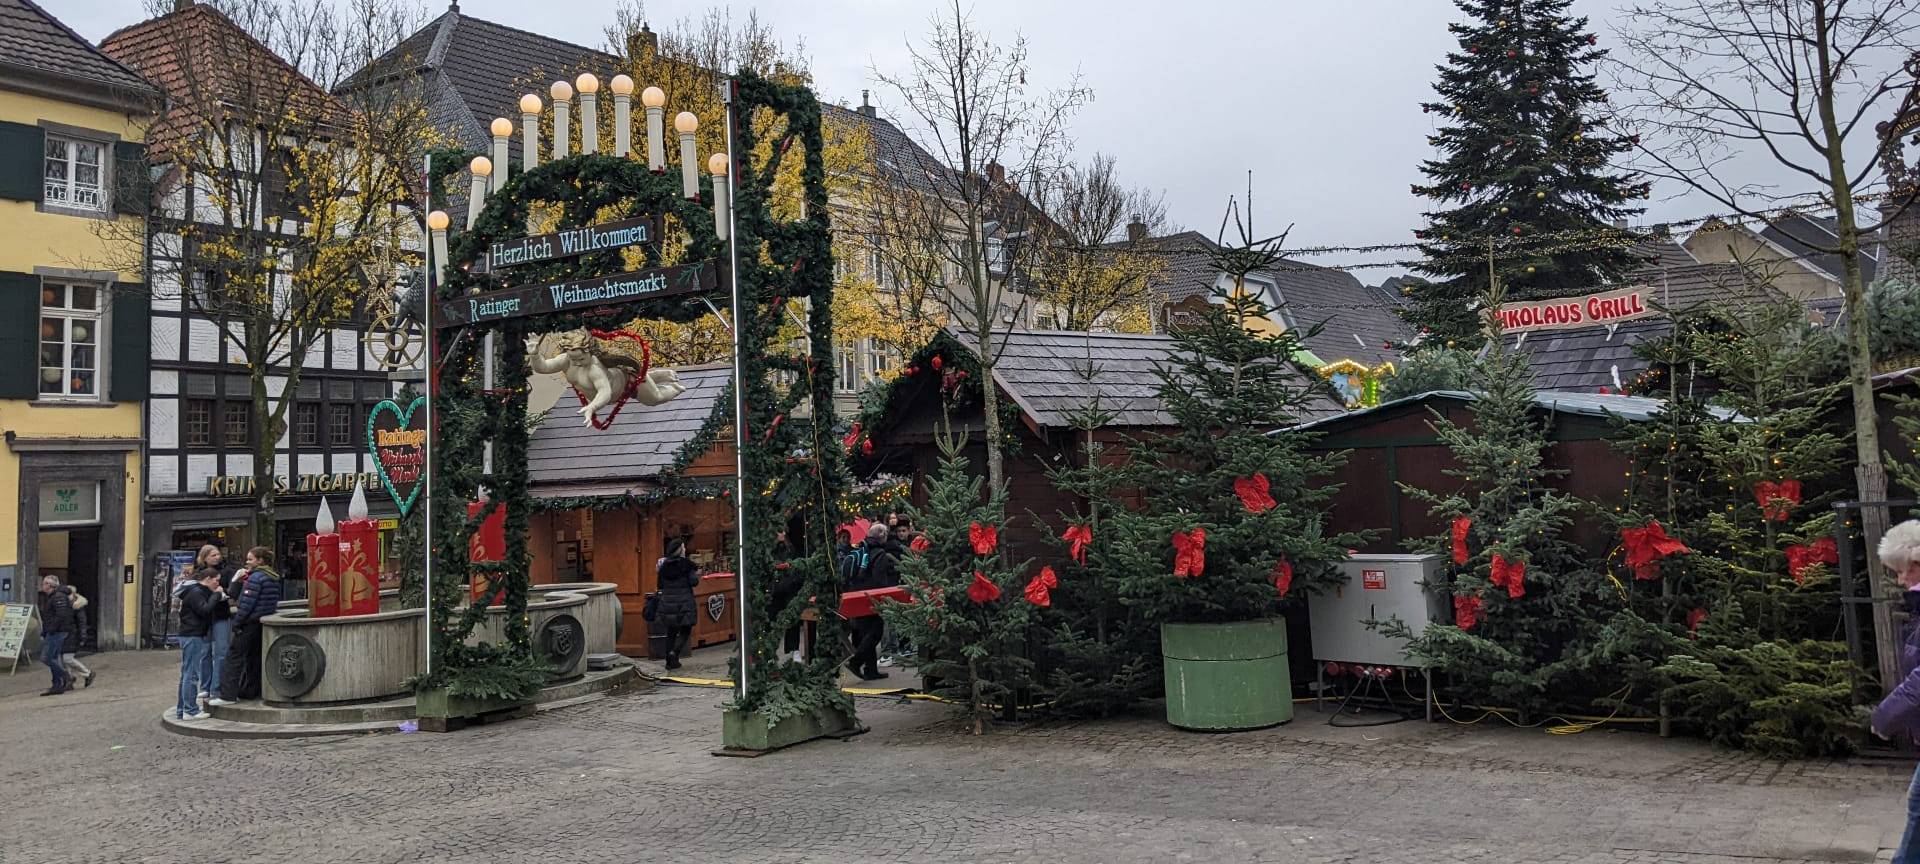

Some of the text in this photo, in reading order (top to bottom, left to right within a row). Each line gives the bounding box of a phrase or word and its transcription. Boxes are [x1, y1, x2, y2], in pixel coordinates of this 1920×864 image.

[491, 225, 647, 266] Herzlich Willkommen
[469, 273, 668, 322] Ratinger Weihnachtsmarkt
[1587, 294, 1644, 321] GRILL
[208, 472, 385, 497] KRINS ZIGARRE
[54, 503, 79, 512] ADLER
